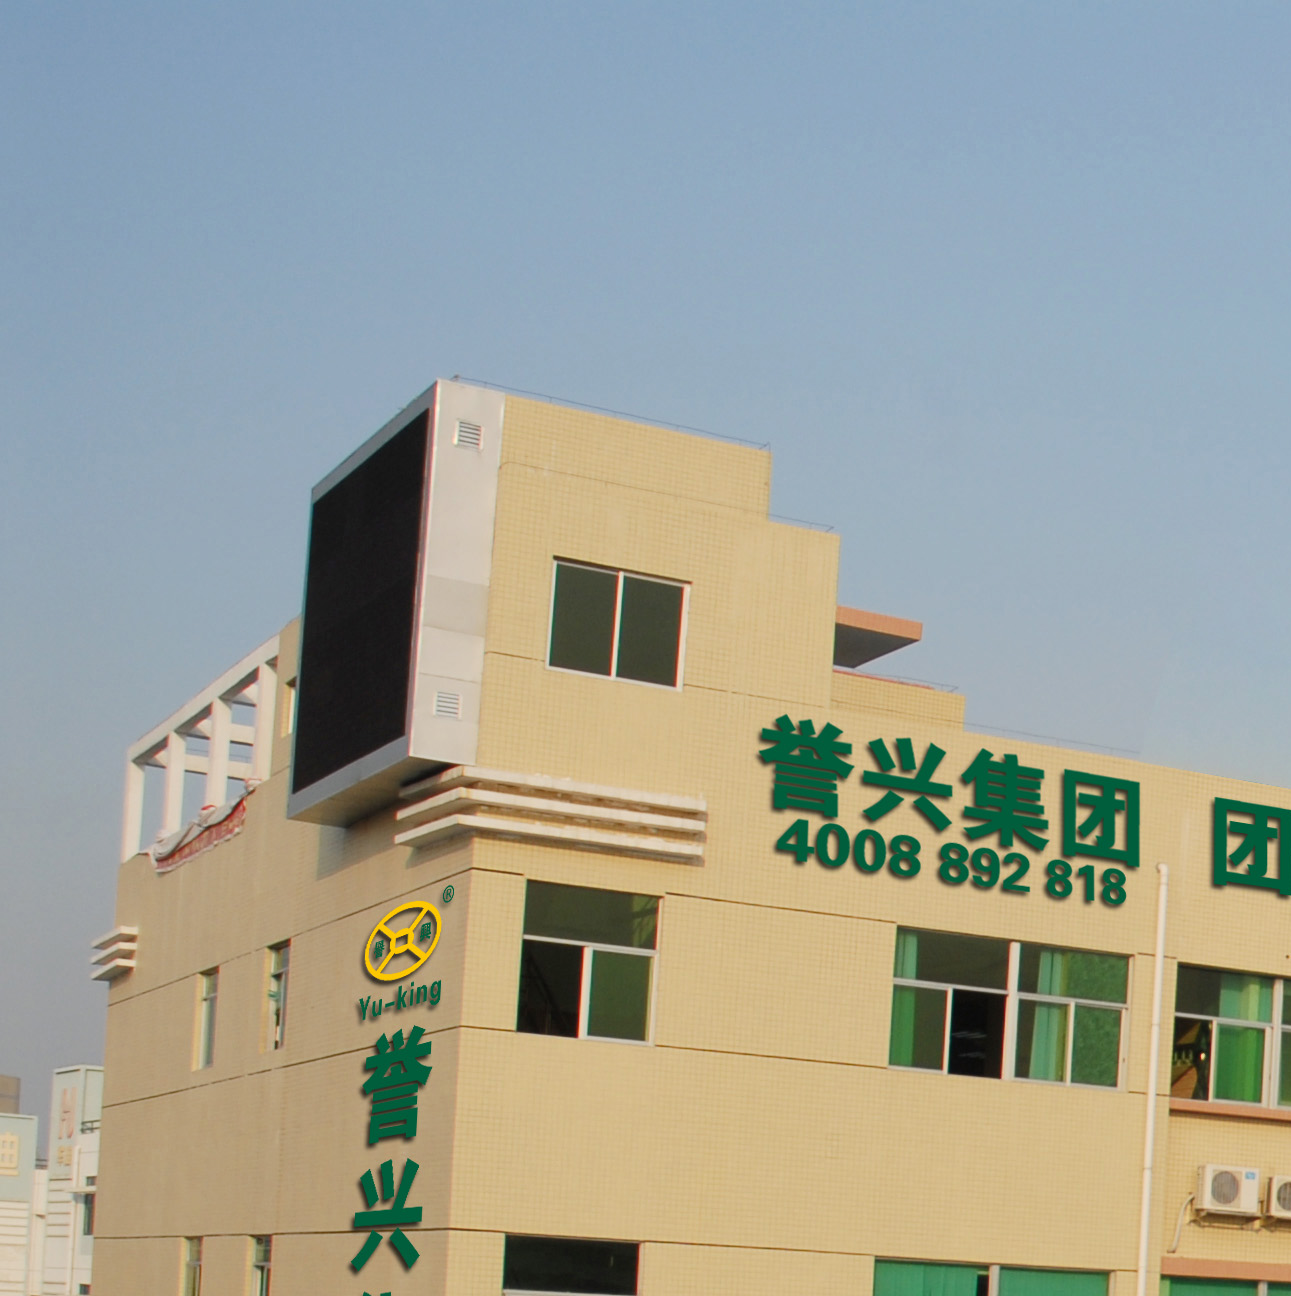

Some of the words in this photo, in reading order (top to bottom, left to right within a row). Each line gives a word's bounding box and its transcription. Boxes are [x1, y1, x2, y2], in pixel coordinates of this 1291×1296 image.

[759, 714, 1140, 868] 誉兴集团
[776, 818, 921, 877] 4008
[939, 842, 1031, 893] 892
[1046, 859, 1127, 905] 818
[359, 979, 442, 1021] Yu-king
